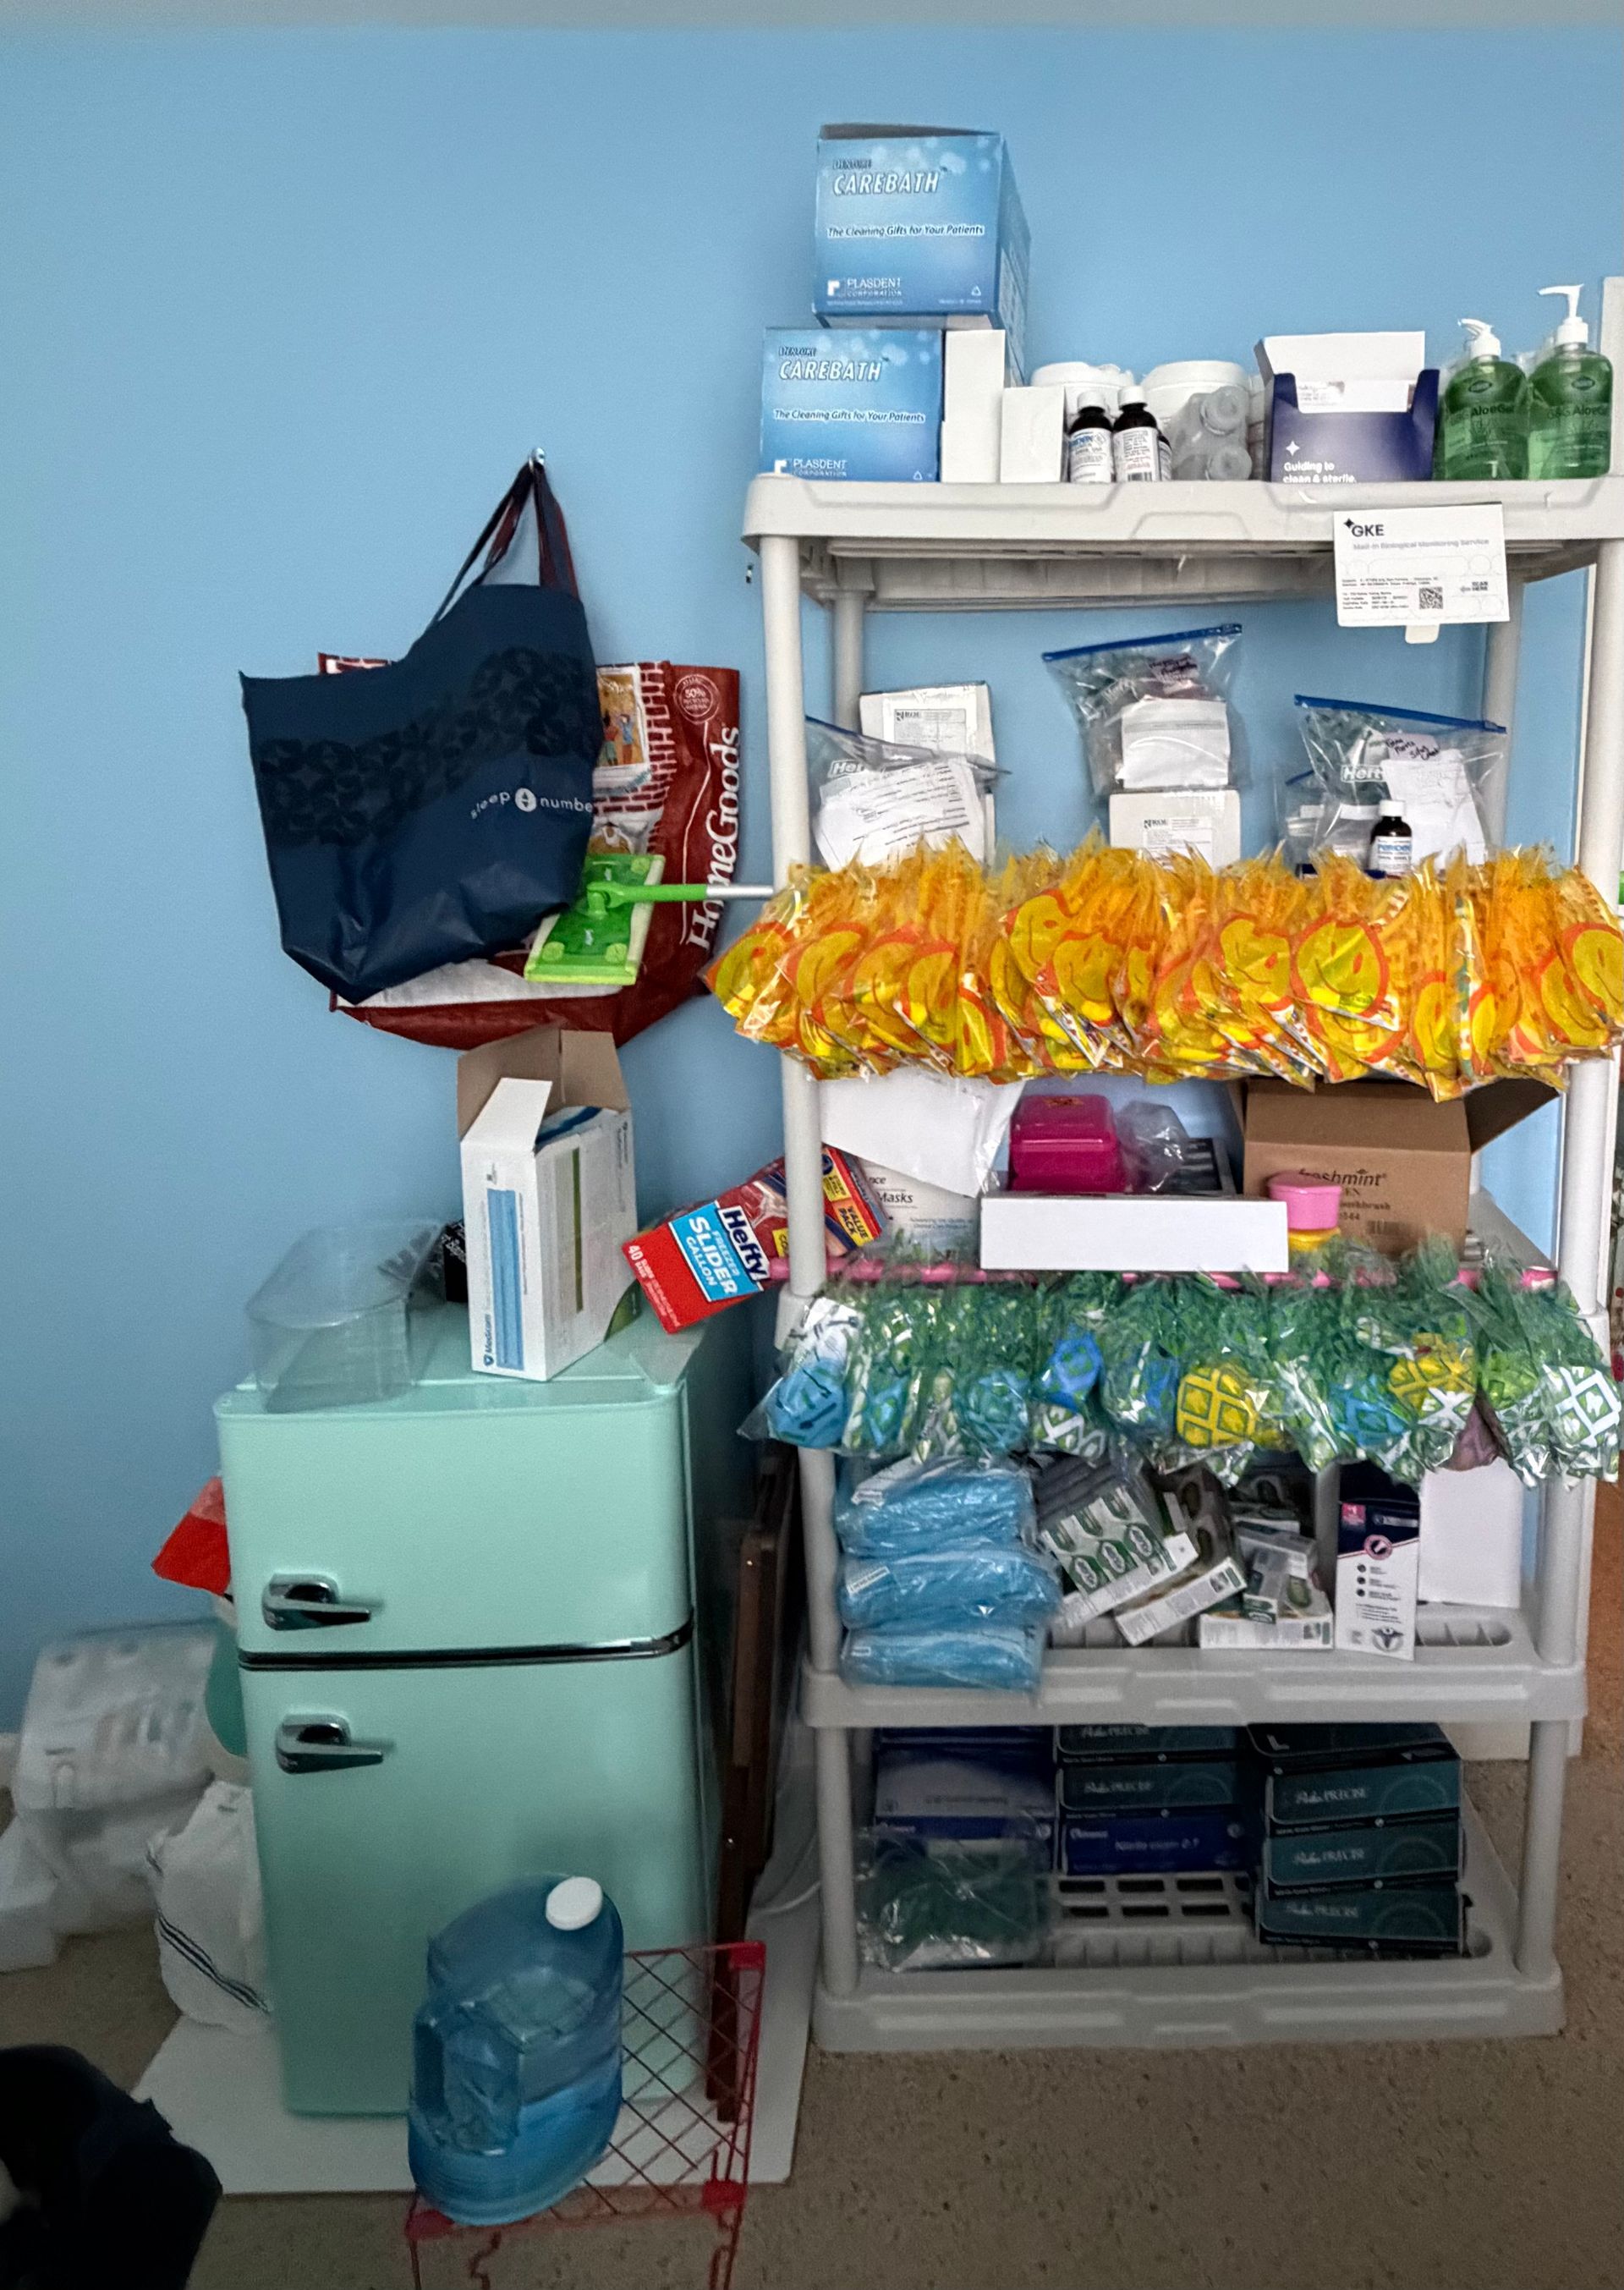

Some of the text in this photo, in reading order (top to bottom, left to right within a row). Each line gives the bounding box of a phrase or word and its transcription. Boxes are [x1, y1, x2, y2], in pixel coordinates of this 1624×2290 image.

[832, 172, 941, 196] CAREBATH
[829, 224, 984, 239] The Cleaning Gifts for Your Patients
[847, 277, 902, 289] PLASDENT
[779, 360, 883, 382] CAREBATH
[775, 409, 925, 424] The Cleaning Gifts for Your Patients
[793, 459, 848, 470] PLASDENT
[1283, 461, 1336, 474] Guiding to
[1282, 474, 1312, 483] clean
[1312, 475, 1321, 483] &
[1351, 524, 1385, 537] GKE
[1461, 538, 1490, 546] Service
[684, 688, 707, 699] 50%
[470, 791, 511, 820] sleep
[687, 726, 739, 950] HomeGoods
[837, 1207, 858, 1235] PACK
[845, 1206, 869, 1239] VALUE
[628, 1244, 641, 1262] 40
[688, 1216, 738, 1294] SLIDER
[710, 1229, 739, 1277] FREEZER
[722, 1208, 771, 1281] Hefty
[684, 1236, 718, 1287] GALLON
[484, 1313, 493, 1355] Medicom
